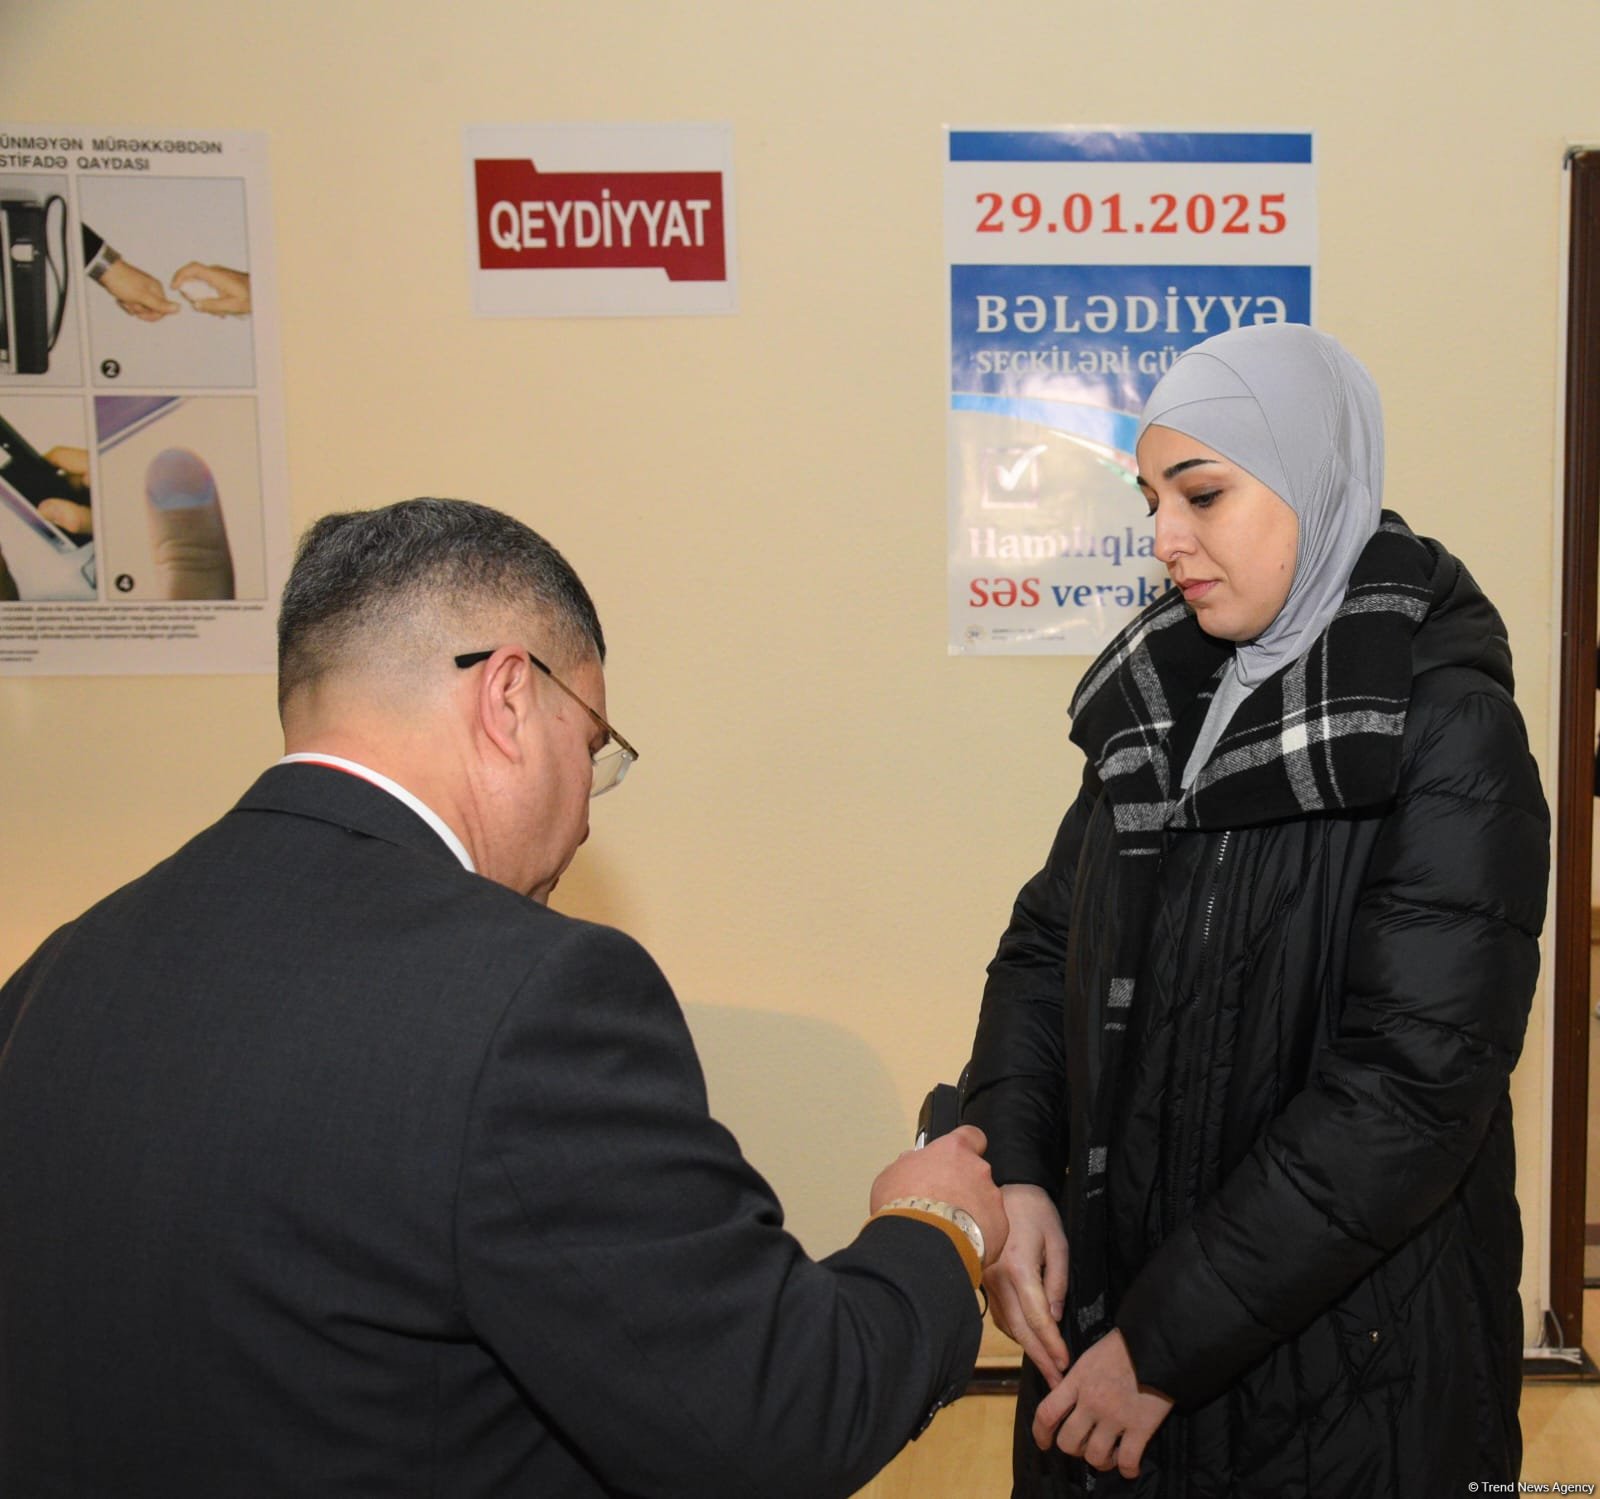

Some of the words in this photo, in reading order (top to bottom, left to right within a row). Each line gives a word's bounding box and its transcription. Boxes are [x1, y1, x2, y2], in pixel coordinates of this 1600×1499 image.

[92, 137, 223, 154] MÜRƏKKƏBDƏN
[77, 156, 150, 170] QAYDASI
[489, 189, 711, 252] QEYDİYYAT
[976, 192, 1287, 234] 29.01.2025
[976, 286, 1287, 334] BƏLƏDİYYƏ
[1138, 345, 1183, 375] GÜ
[969, 577, 1041, 608] SƏS
